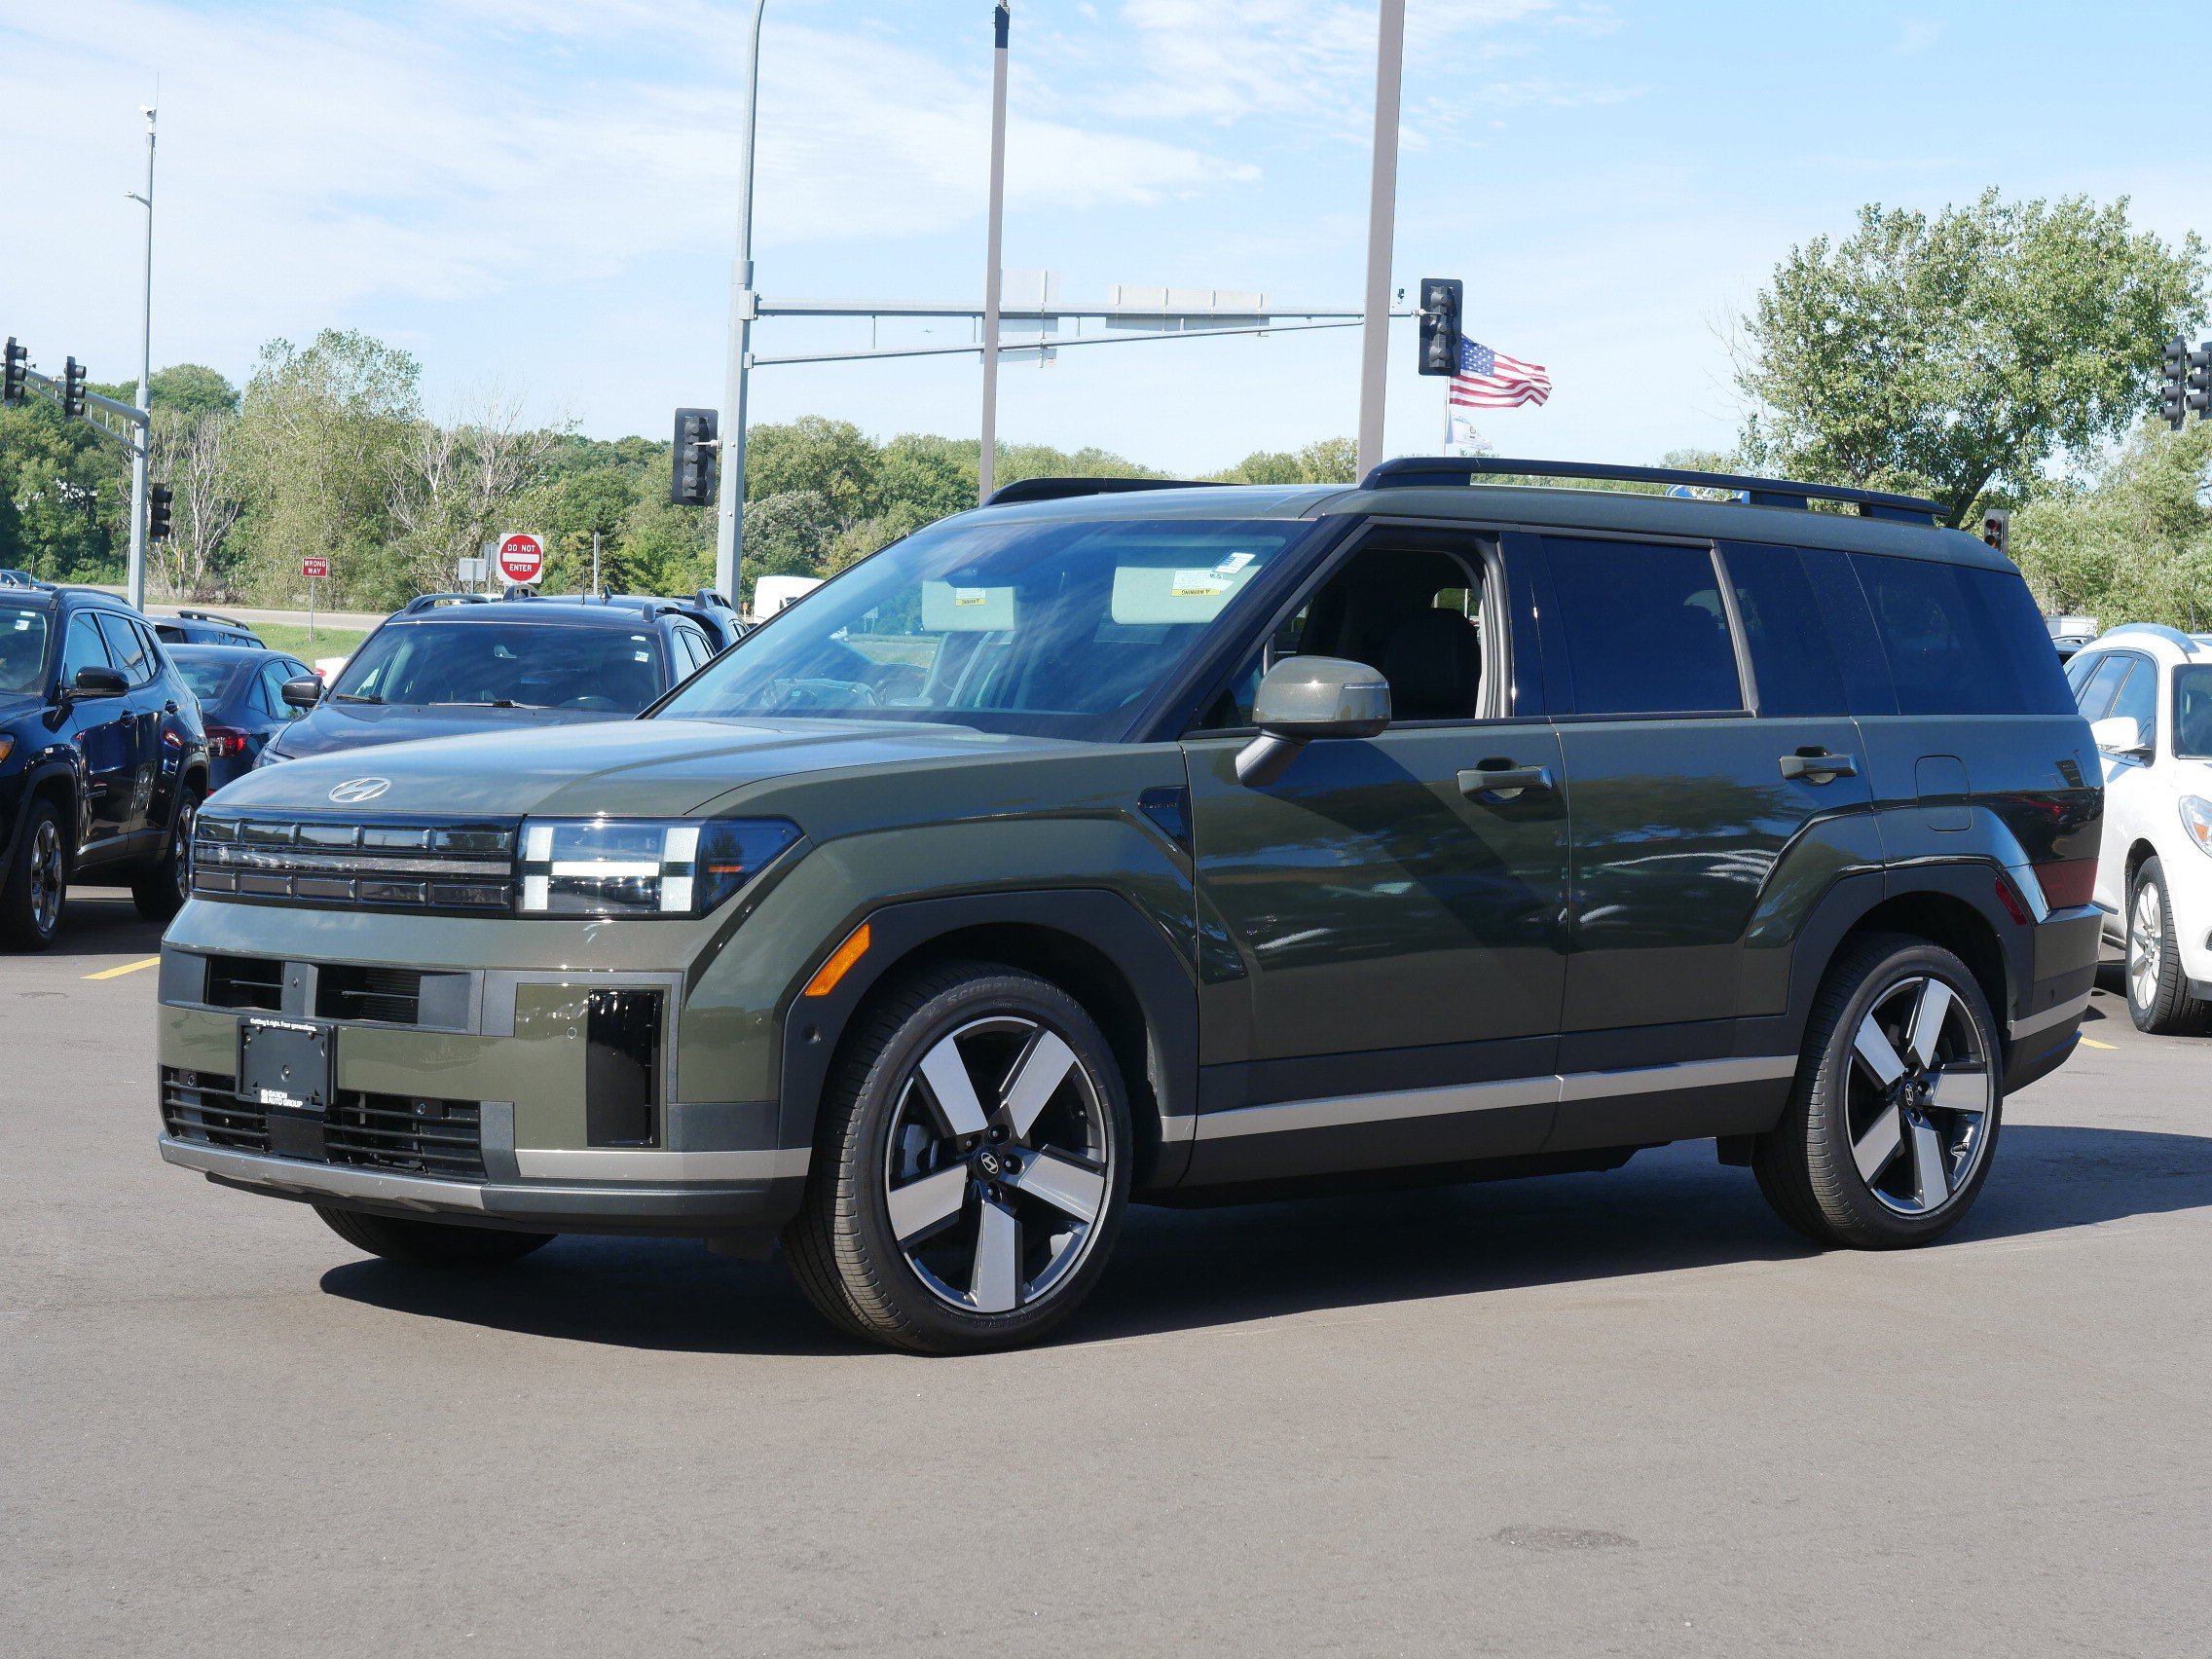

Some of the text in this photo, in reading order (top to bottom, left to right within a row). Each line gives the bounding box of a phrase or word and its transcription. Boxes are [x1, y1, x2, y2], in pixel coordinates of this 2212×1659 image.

[507, 543, 536, 553] DO NOT
[509, 564, 533, 572] ENTER
